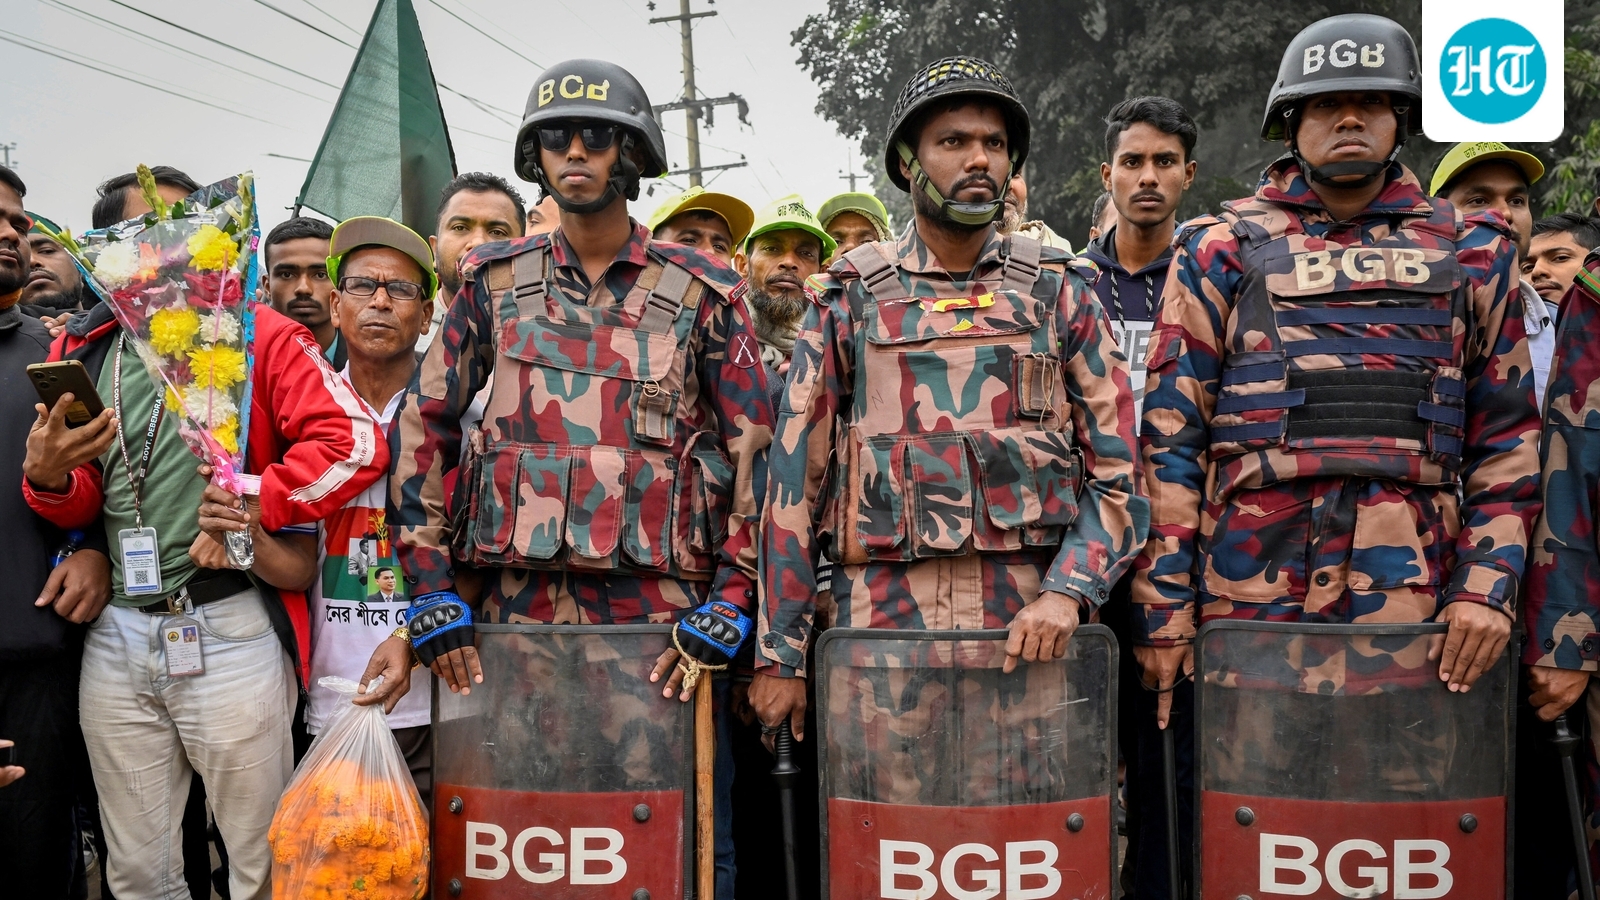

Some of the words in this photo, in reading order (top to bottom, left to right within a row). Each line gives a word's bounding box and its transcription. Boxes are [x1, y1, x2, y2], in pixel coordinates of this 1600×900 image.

[1294, 247, 1430, 291] BGB
[147, 399, 163, 437] DEBENDRA
[465, 820, 628, 885] BGB
[879, 839, 1063, 900] BGB
[1259, 832, 1454, 900] BGB
